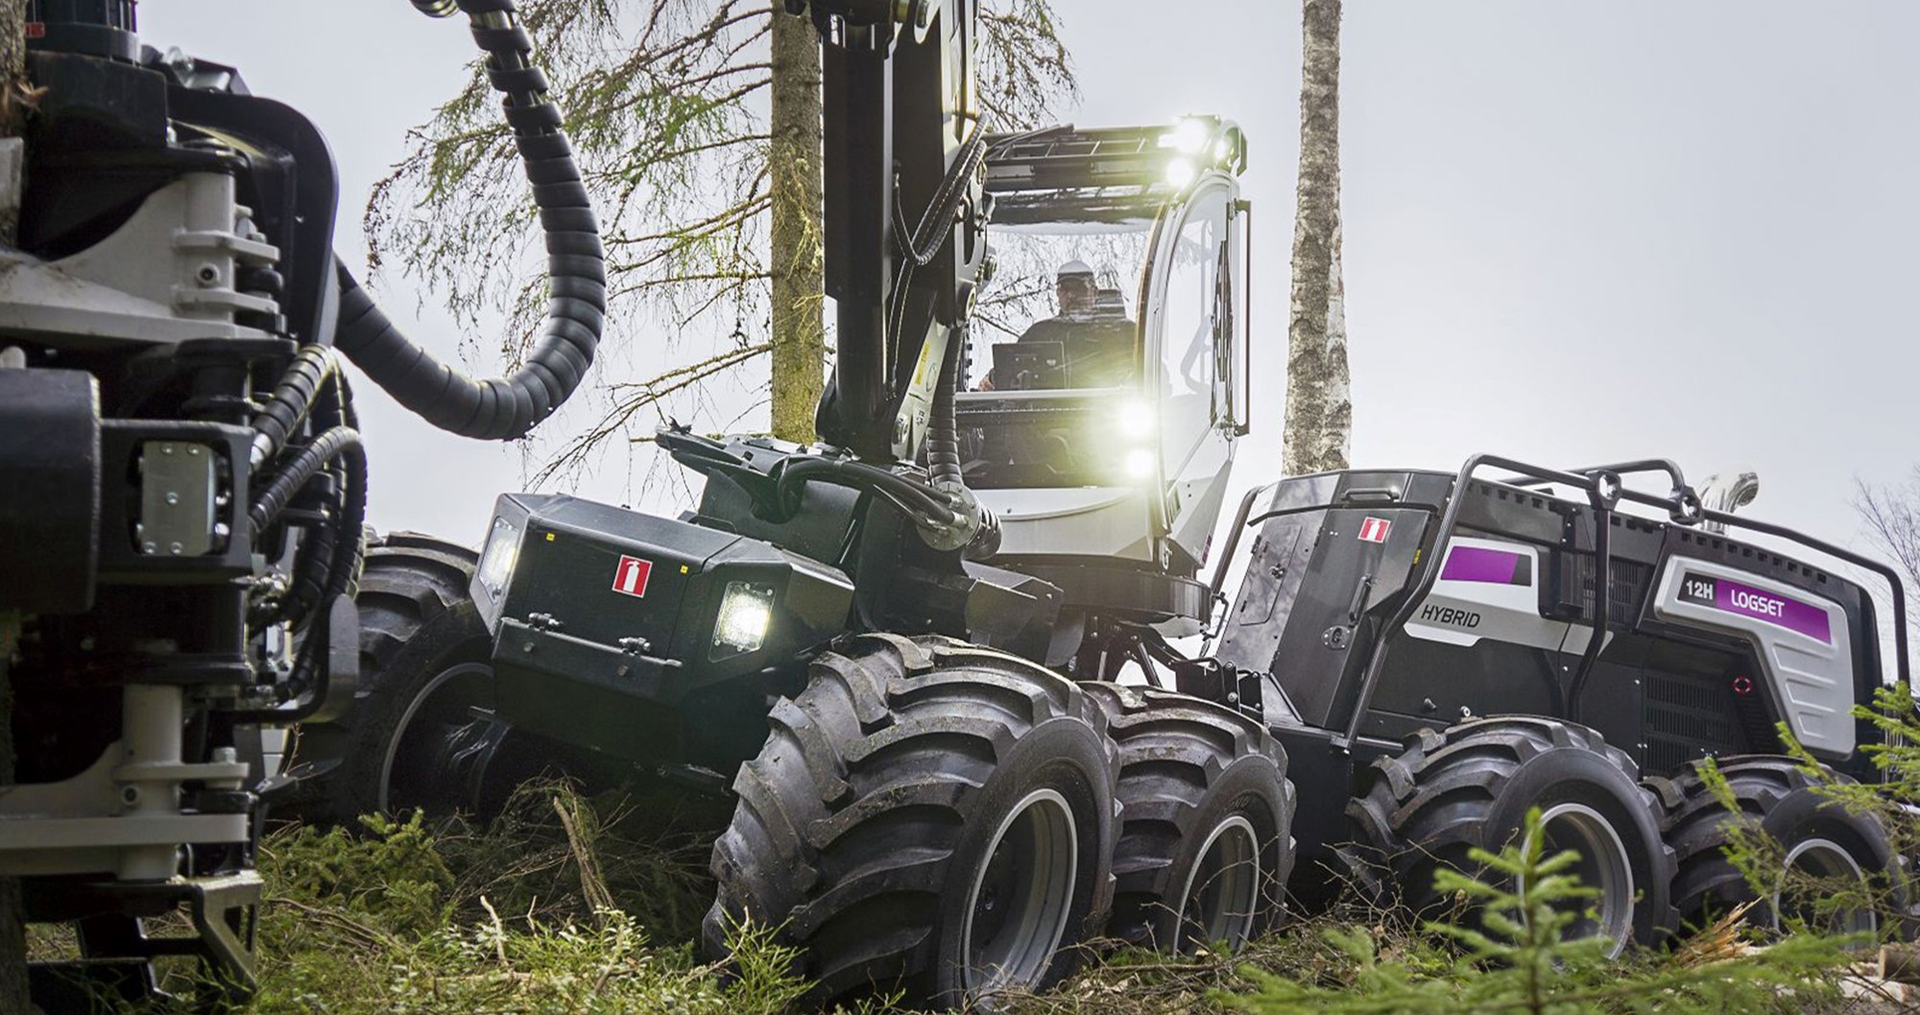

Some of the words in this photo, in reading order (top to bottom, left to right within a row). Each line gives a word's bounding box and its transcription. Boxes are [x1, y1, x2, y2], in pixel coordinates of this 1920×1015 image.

[1686, 580, 1713, 600] 12H
[1731, 589, 1785, 617] LOGSET
[1420, 604, 1481, 628] HYBRID
